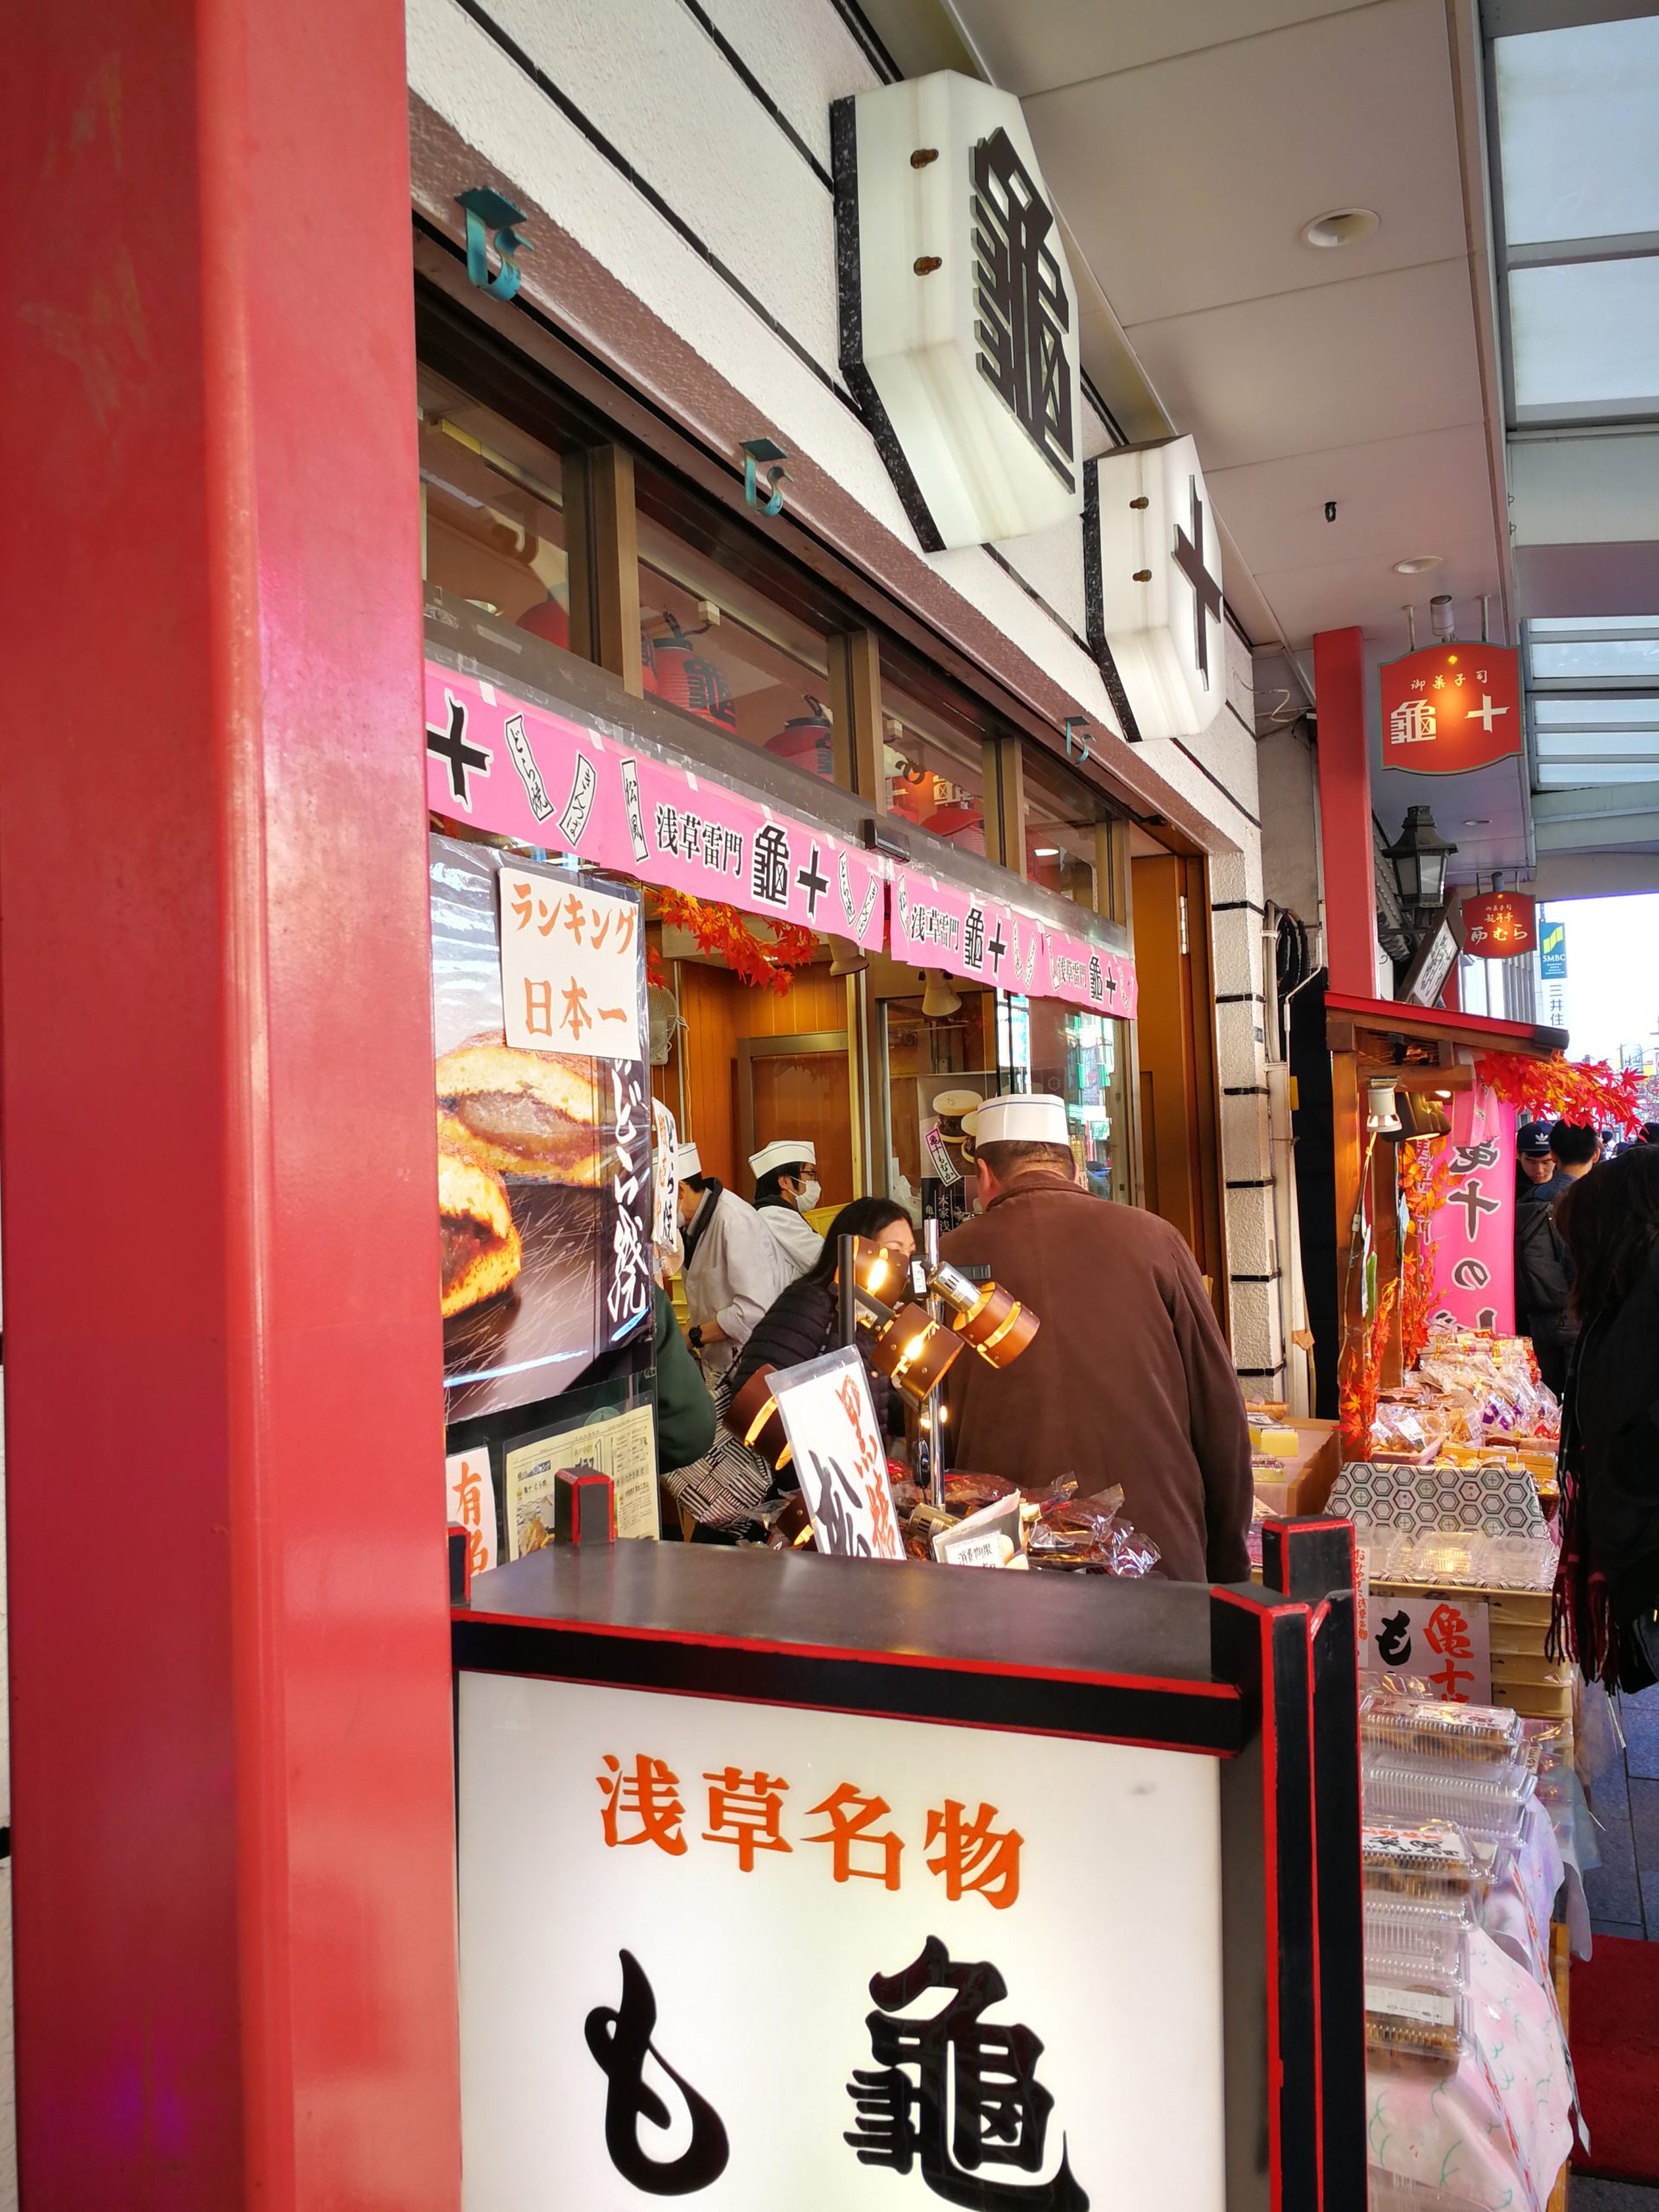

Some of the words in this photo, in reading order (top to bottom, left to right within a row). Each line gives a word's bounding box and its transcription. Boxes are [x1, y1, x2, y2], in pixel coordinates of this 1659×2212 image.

[1172, 475, 1222, 691] 十
[1410, 671, 1488, 691] 御菓子司
[656, 807, 743, 876] 浅草雷門
[512, 883, 638, 954] ランキング
[912, 906, 960, 950] 浅草雷門
[524, 976, 627, 1040] 日本一
[596, 1752, 1025, 1910] 浅草名物
[585, 1948, 729, 2196] も
